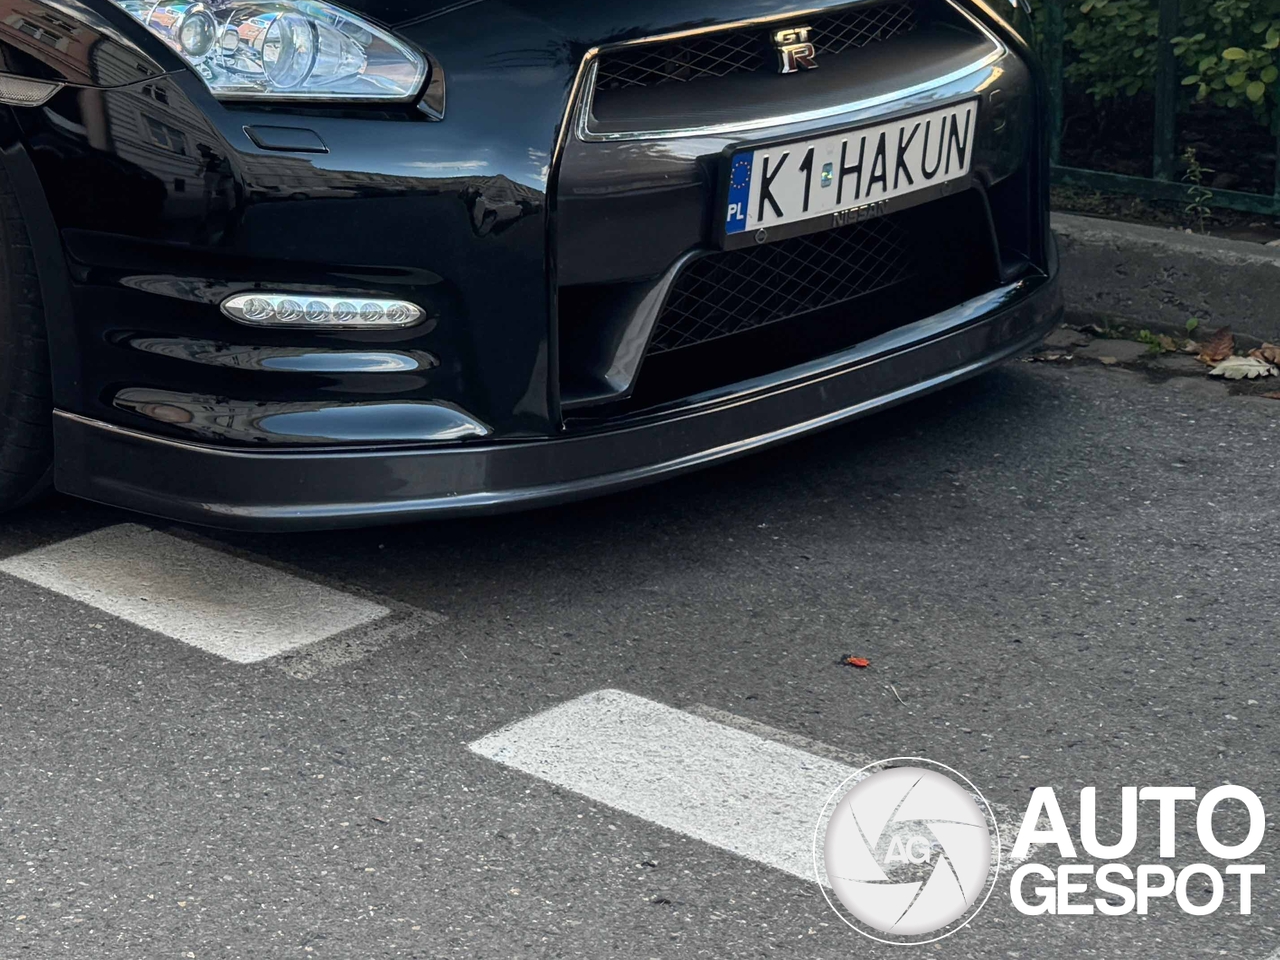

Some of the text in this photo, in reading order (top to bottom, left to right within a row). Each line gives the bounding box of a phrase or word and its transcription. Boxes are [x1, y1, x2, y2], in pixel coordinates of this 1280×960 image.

[835, 108, 971, 205] HAKUN
[726, 203, 745, 222] PL
[832, 199, 889, 228] NISSAN
